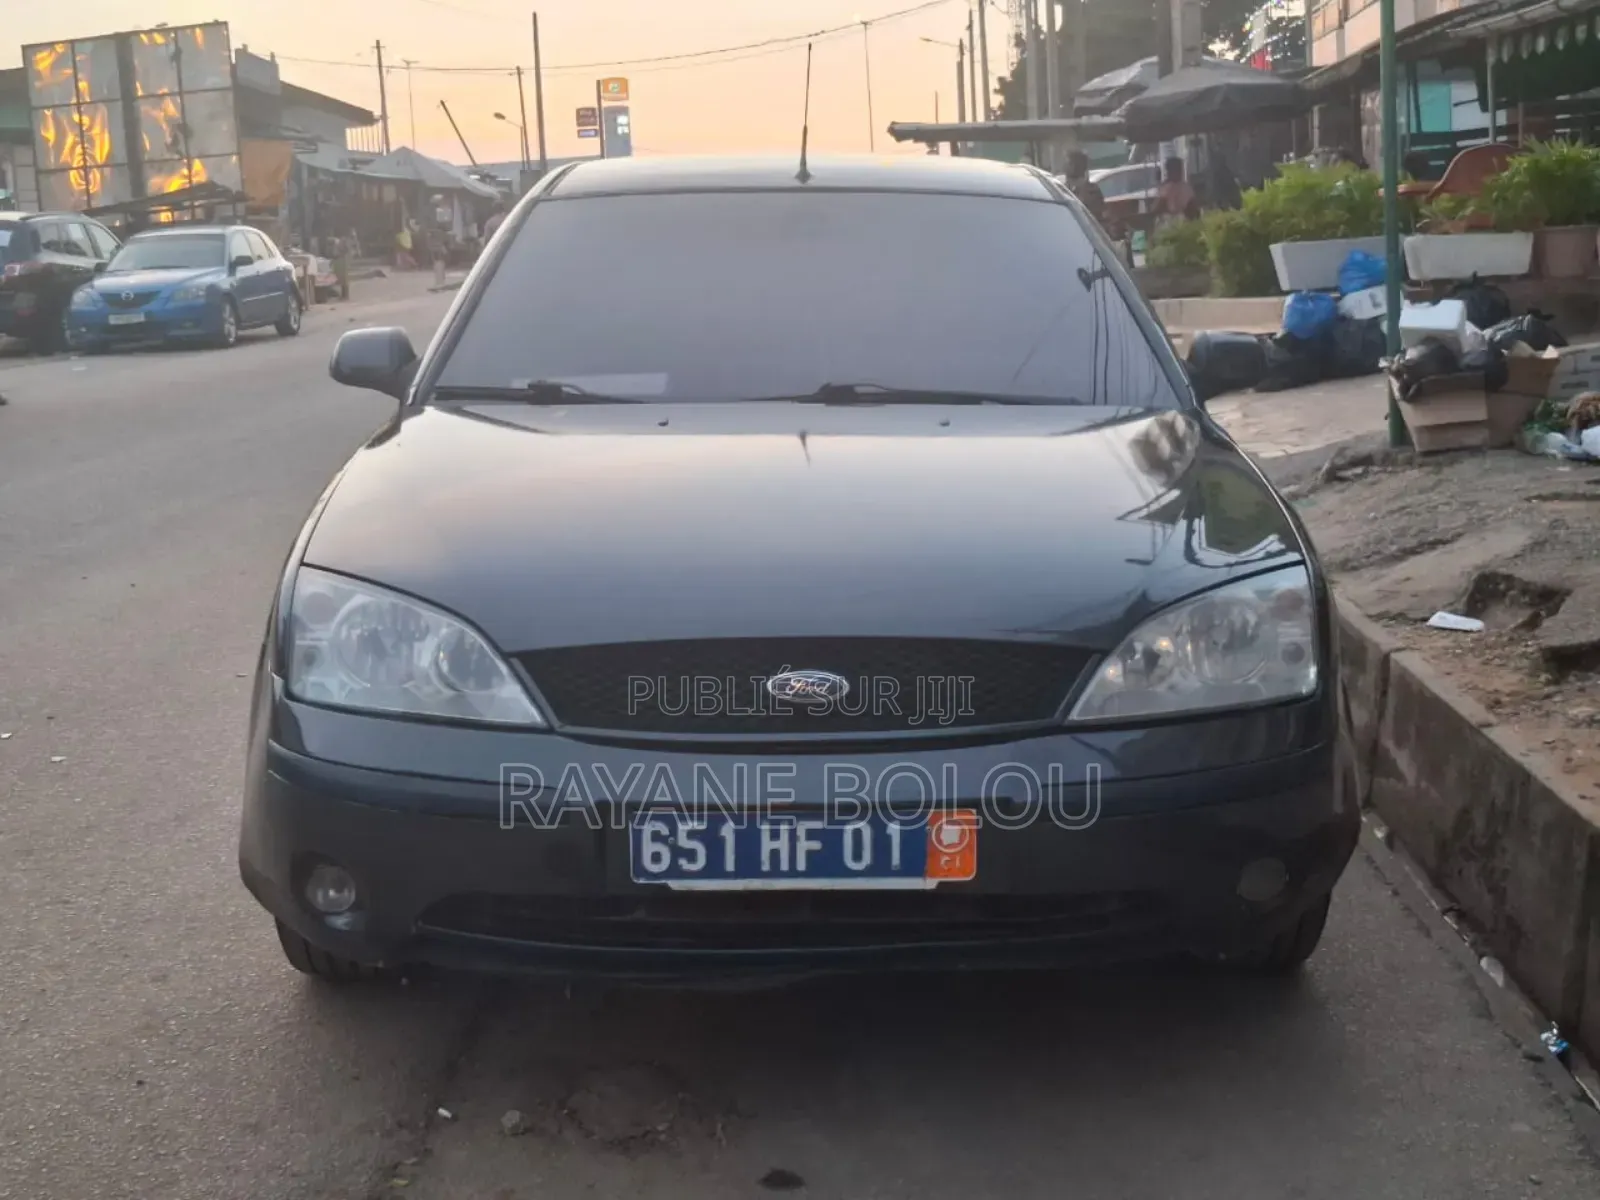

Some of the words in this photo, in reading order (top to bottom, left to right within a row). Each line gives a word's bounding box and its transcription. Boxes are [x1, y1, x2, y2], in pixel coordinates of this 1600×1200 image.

[642, 820, 736, 873] 651
[760, 821, 822, 872] HF
[843, 820, 900, 871] 01
